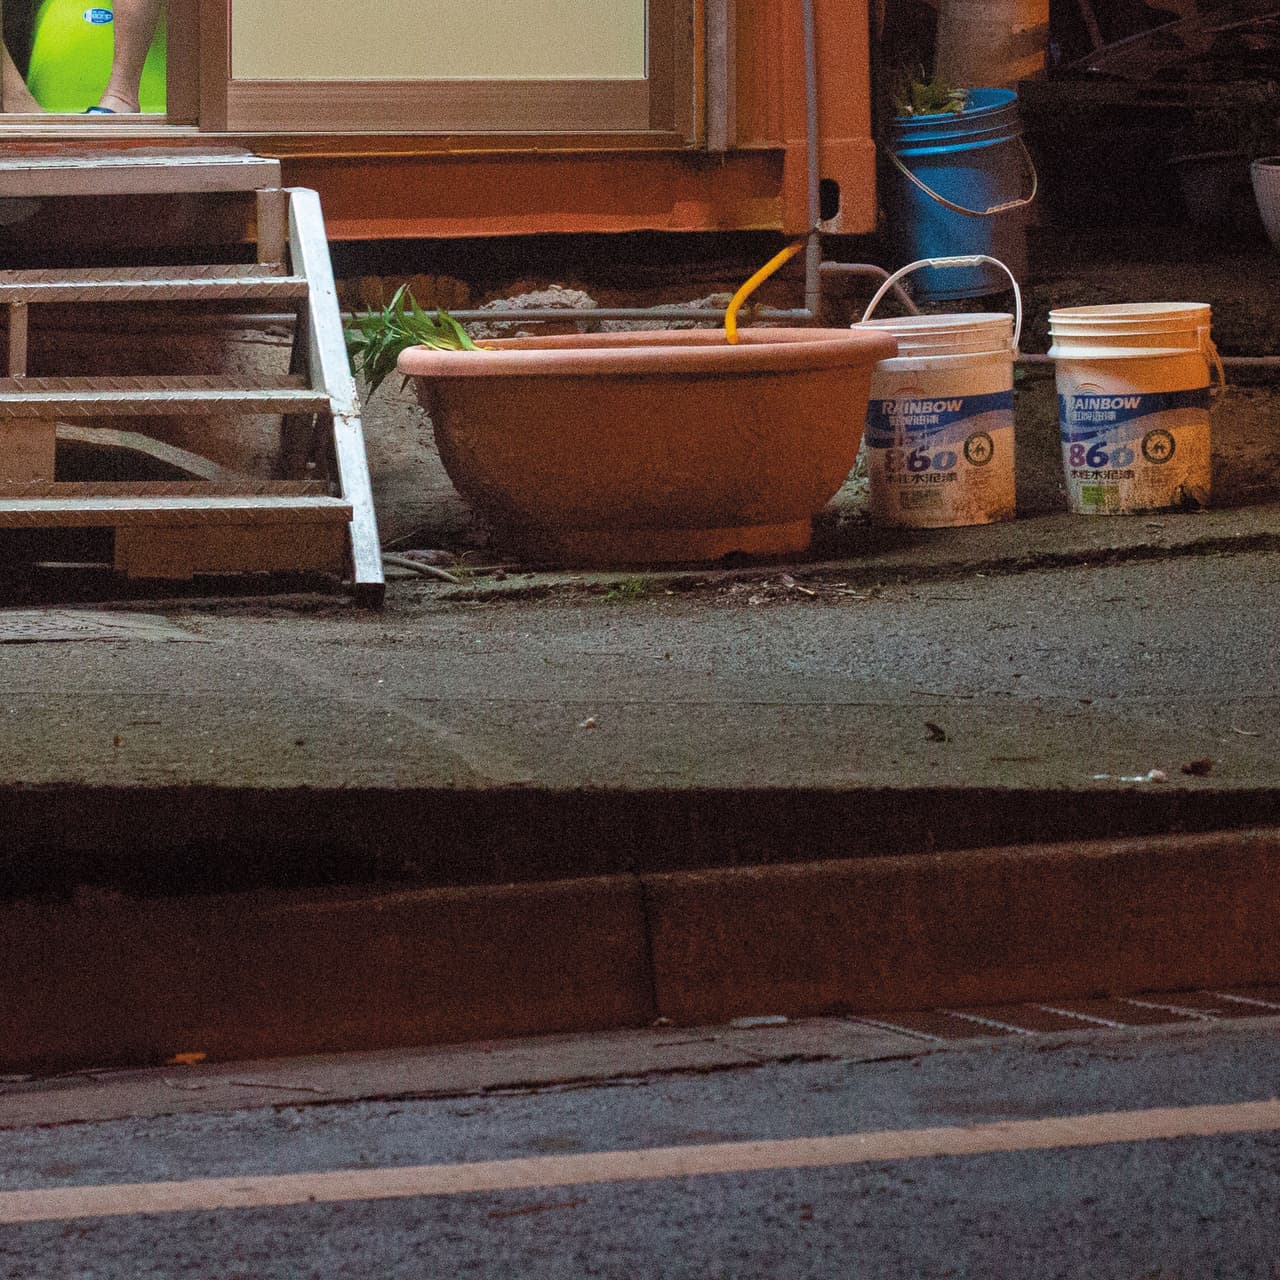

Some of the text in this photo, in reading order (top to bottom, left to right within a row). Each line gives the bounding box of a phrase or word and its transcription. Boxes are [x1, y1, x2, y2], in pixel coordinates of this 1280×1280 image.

[881, 399, 963, 415] RAINBOW
[884, 444, 958, 473] 860
[1069, 441, 1134, 469] 860
